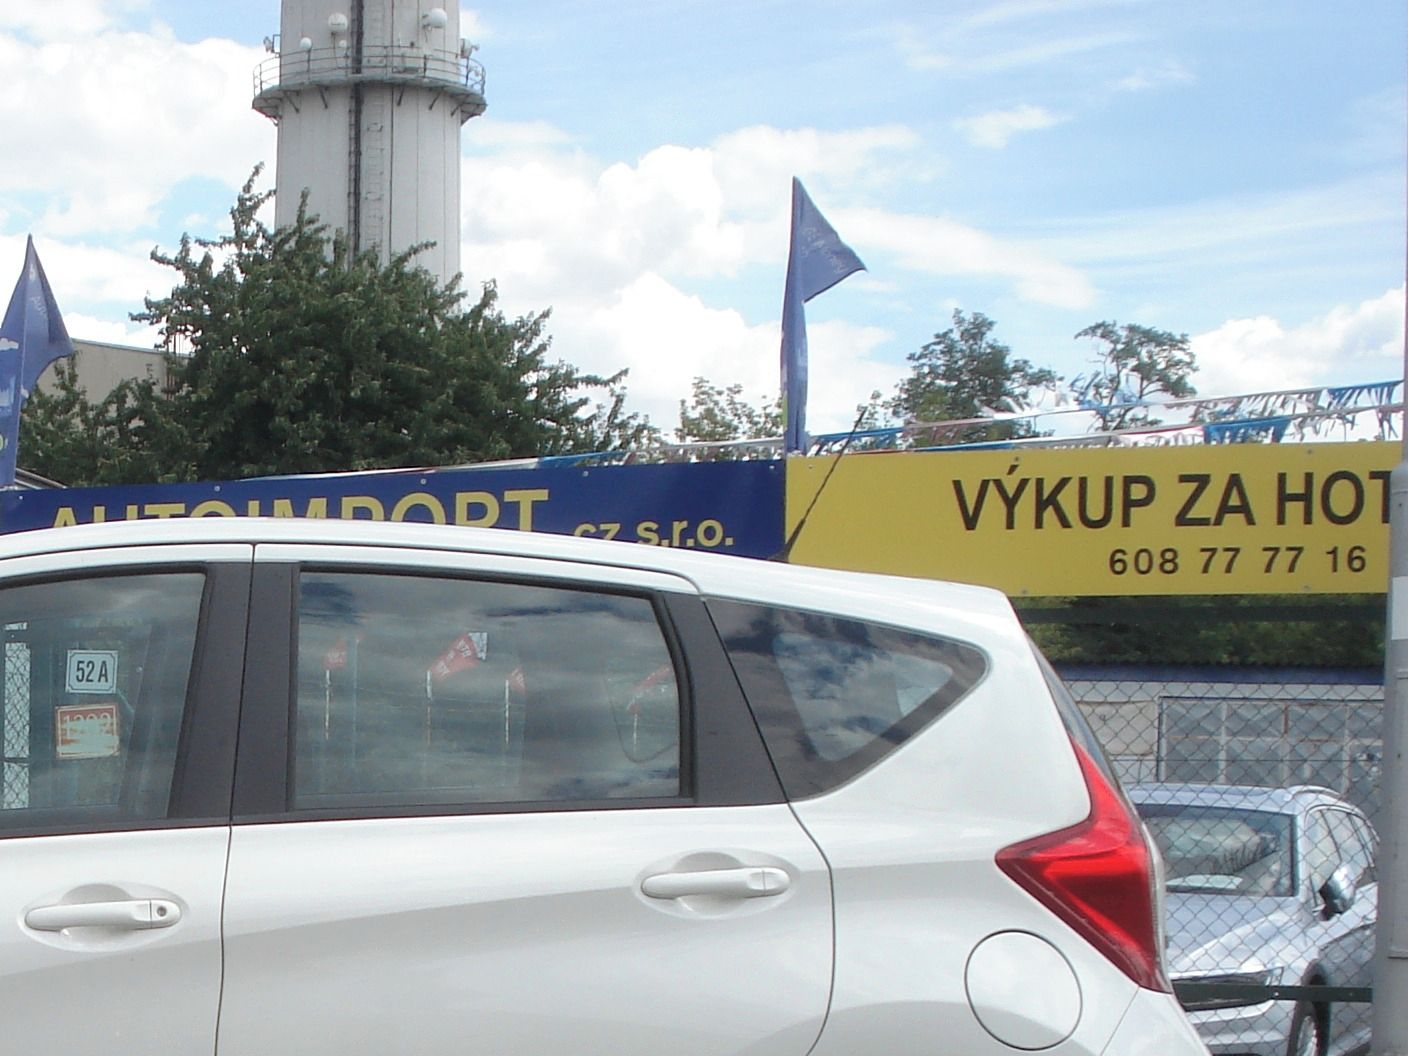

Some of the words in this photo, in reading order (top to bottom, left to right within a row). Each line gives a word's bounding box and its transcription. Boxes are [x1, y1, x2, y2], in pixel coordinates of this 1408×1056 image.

[952, 464, 1158, 531] VÝKUP
[1175, 473, 1256, 526] ZA
[1276, 470, 1392, 525] HOT
[636, 519, 734, 547] s.r.o.
[1109, 547, 1179, 576] 608
[1200, 547, 1241, 574] 77
[1262, 546, 1304, 573] 77
[1325, 545, 1366, 573] 16
